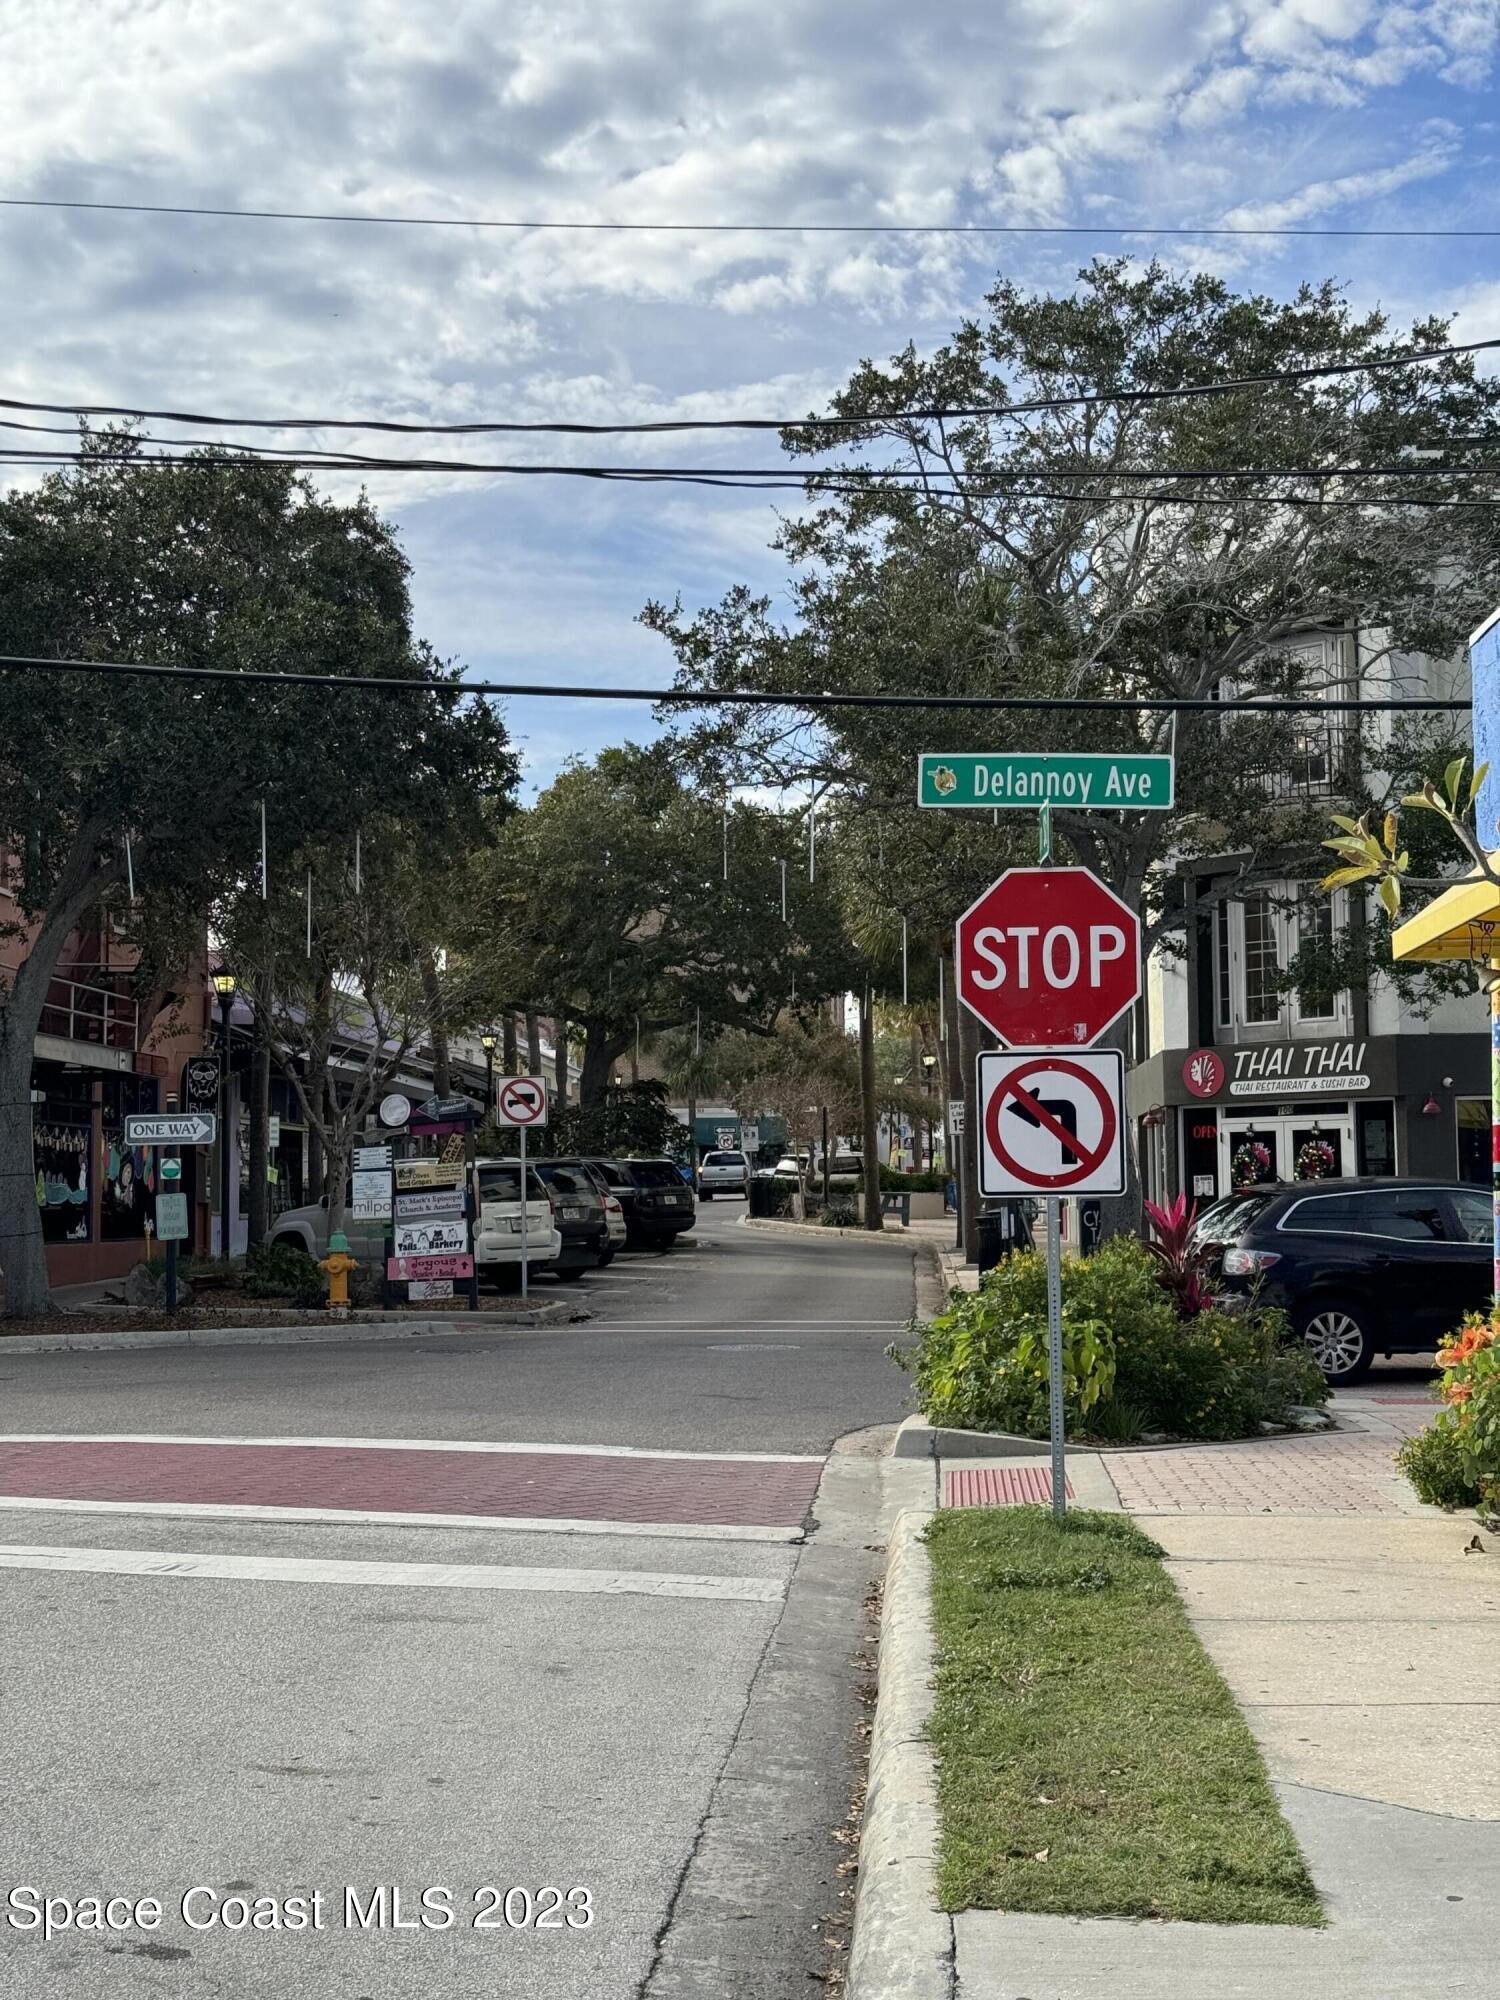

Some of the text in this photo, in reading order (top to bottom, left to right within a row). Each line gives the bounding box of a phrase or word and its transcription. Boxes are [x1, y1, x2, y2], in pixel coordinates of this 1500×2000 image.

[973, 765, 1151, 803] Delannoy Ave
[971, 925, 1126, 989] STOP
[1234, 1042, 1366, 1078] THAI THAI
[1234, 1078, 1366, 1093] THAI RESTAURANT & SUSHI BAR
[134, 1123, 200, 1136] ONE WAY
[1193, 1126, 1217, 1139] OPEN
[399, 1179, 411, 1187] and
[411, 1179, 432, 1187] Grapes
[409, 1196, 431, 1204] Mark's
[432, 1193, 462, 1204] Episcopal
[353, 1199, 391, 1217] milpa
[434, 1203, 462, 1211] Academy
[429, 1239, 464, 1249] Barkery
[411, 1257, 457, 1271] Joyous
